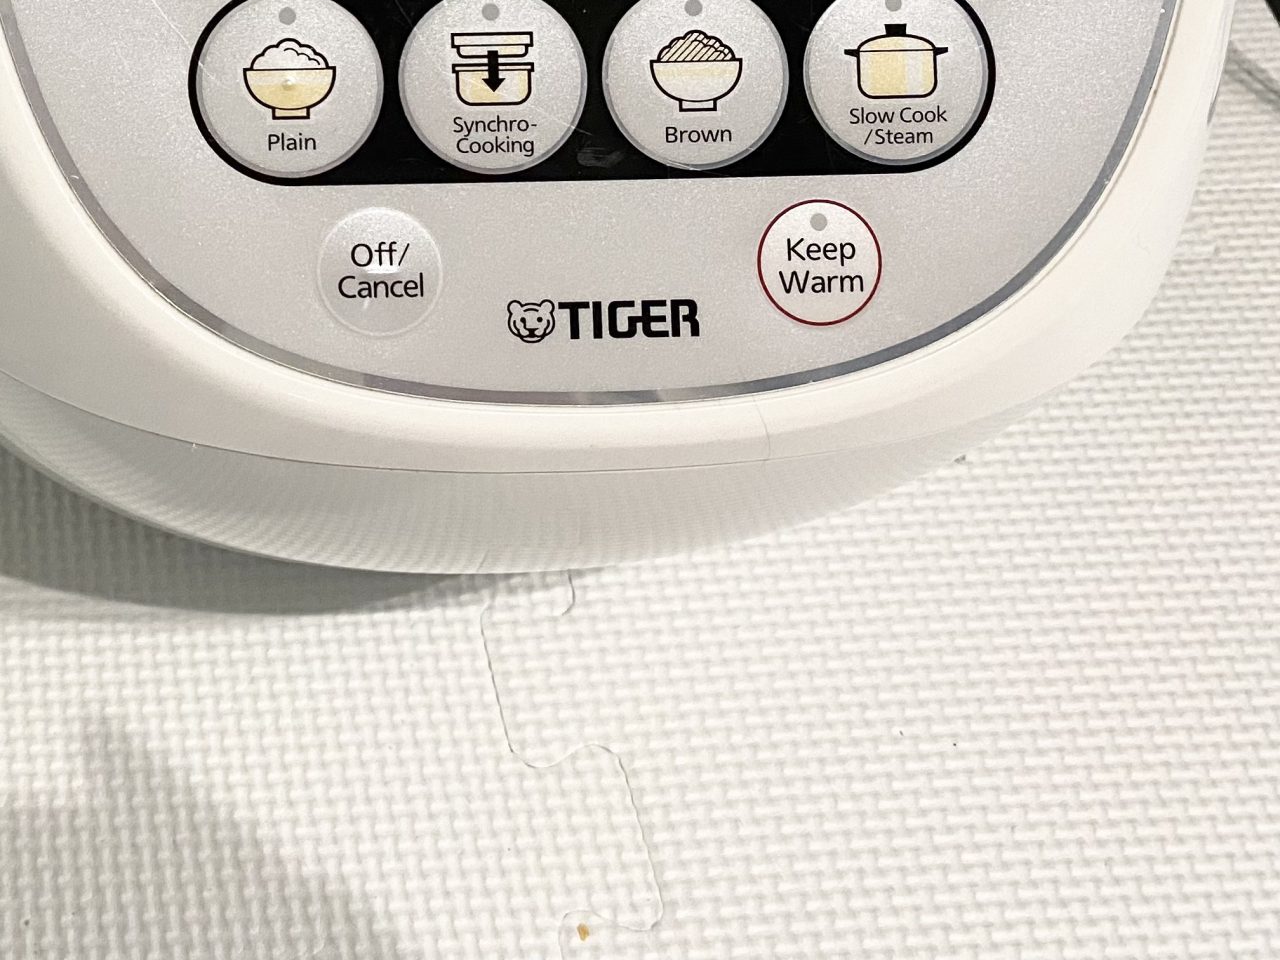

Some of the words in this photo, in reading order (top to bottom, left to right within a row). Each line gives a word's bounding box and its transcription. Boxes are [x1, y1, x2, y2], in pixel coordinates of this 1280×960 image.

[452, 114, 538, 136] Synchro-
[849, 106, 895, 125] Slow
[899, 105, 948, 124] Cook
[267, 131, 318, 153] Plain
[456, 135, 535, 158] Cooking
[665, 126, 733, 144] Brown
[863, 127, 934, 146] /Steam
[350, 240, 411, 268] Off/
[786, 237, 857, 264] Keep
[337, 271, 424, 299] Cancel
[779, 269, 865, 295] Warm
[557, 298, 701, 340] TIGER
